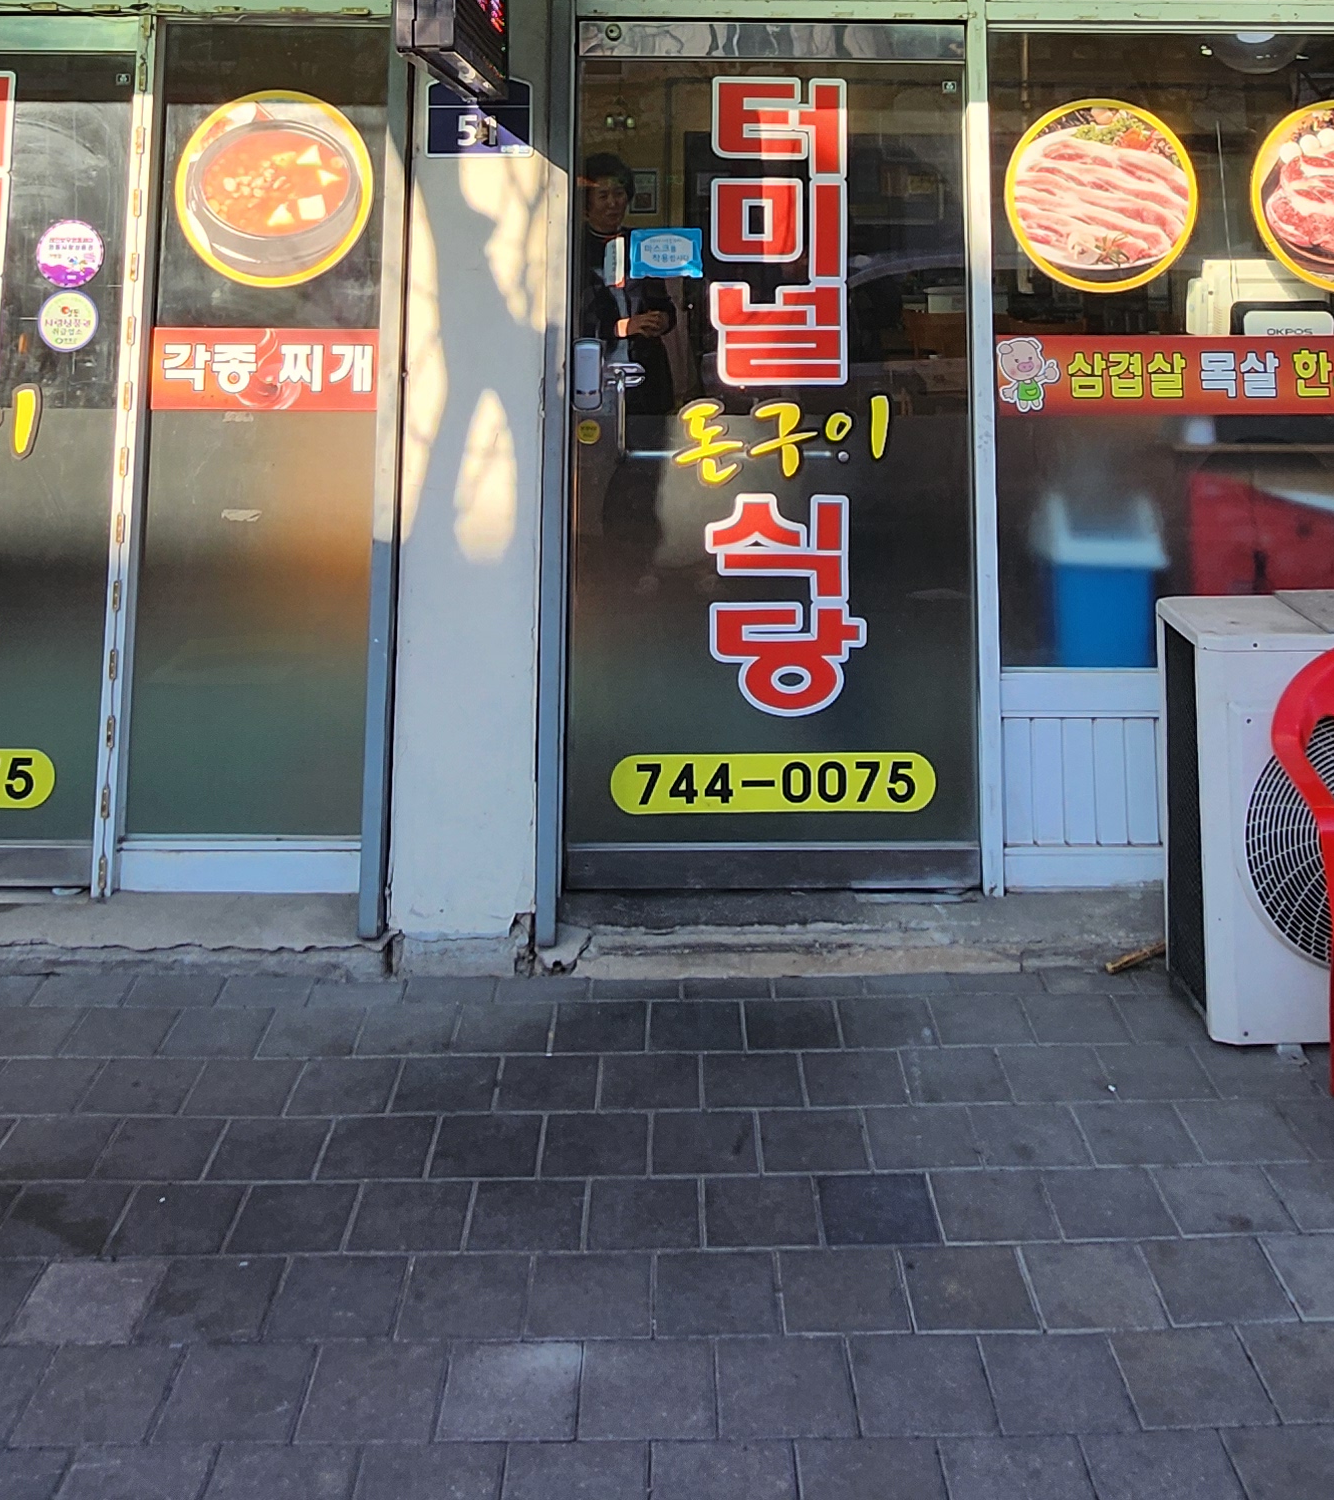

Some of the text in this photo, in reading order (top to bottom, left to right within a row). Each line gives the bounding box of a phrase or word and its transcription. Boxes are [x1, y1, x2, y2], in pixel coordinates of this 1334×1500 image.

[457, 114, 499, 146] 51
[1266, 328, 1314, 336] OKPOS
[160, 343, 375, 394] 각종 찌개
[1066, 349, 1186, 399] 삼겹살
[1199, 350, 1279, 399] 목살
[673, 76, 891, 718] 터미널 돈구이 식당
[634, 759, 918, 806] 744-0075
